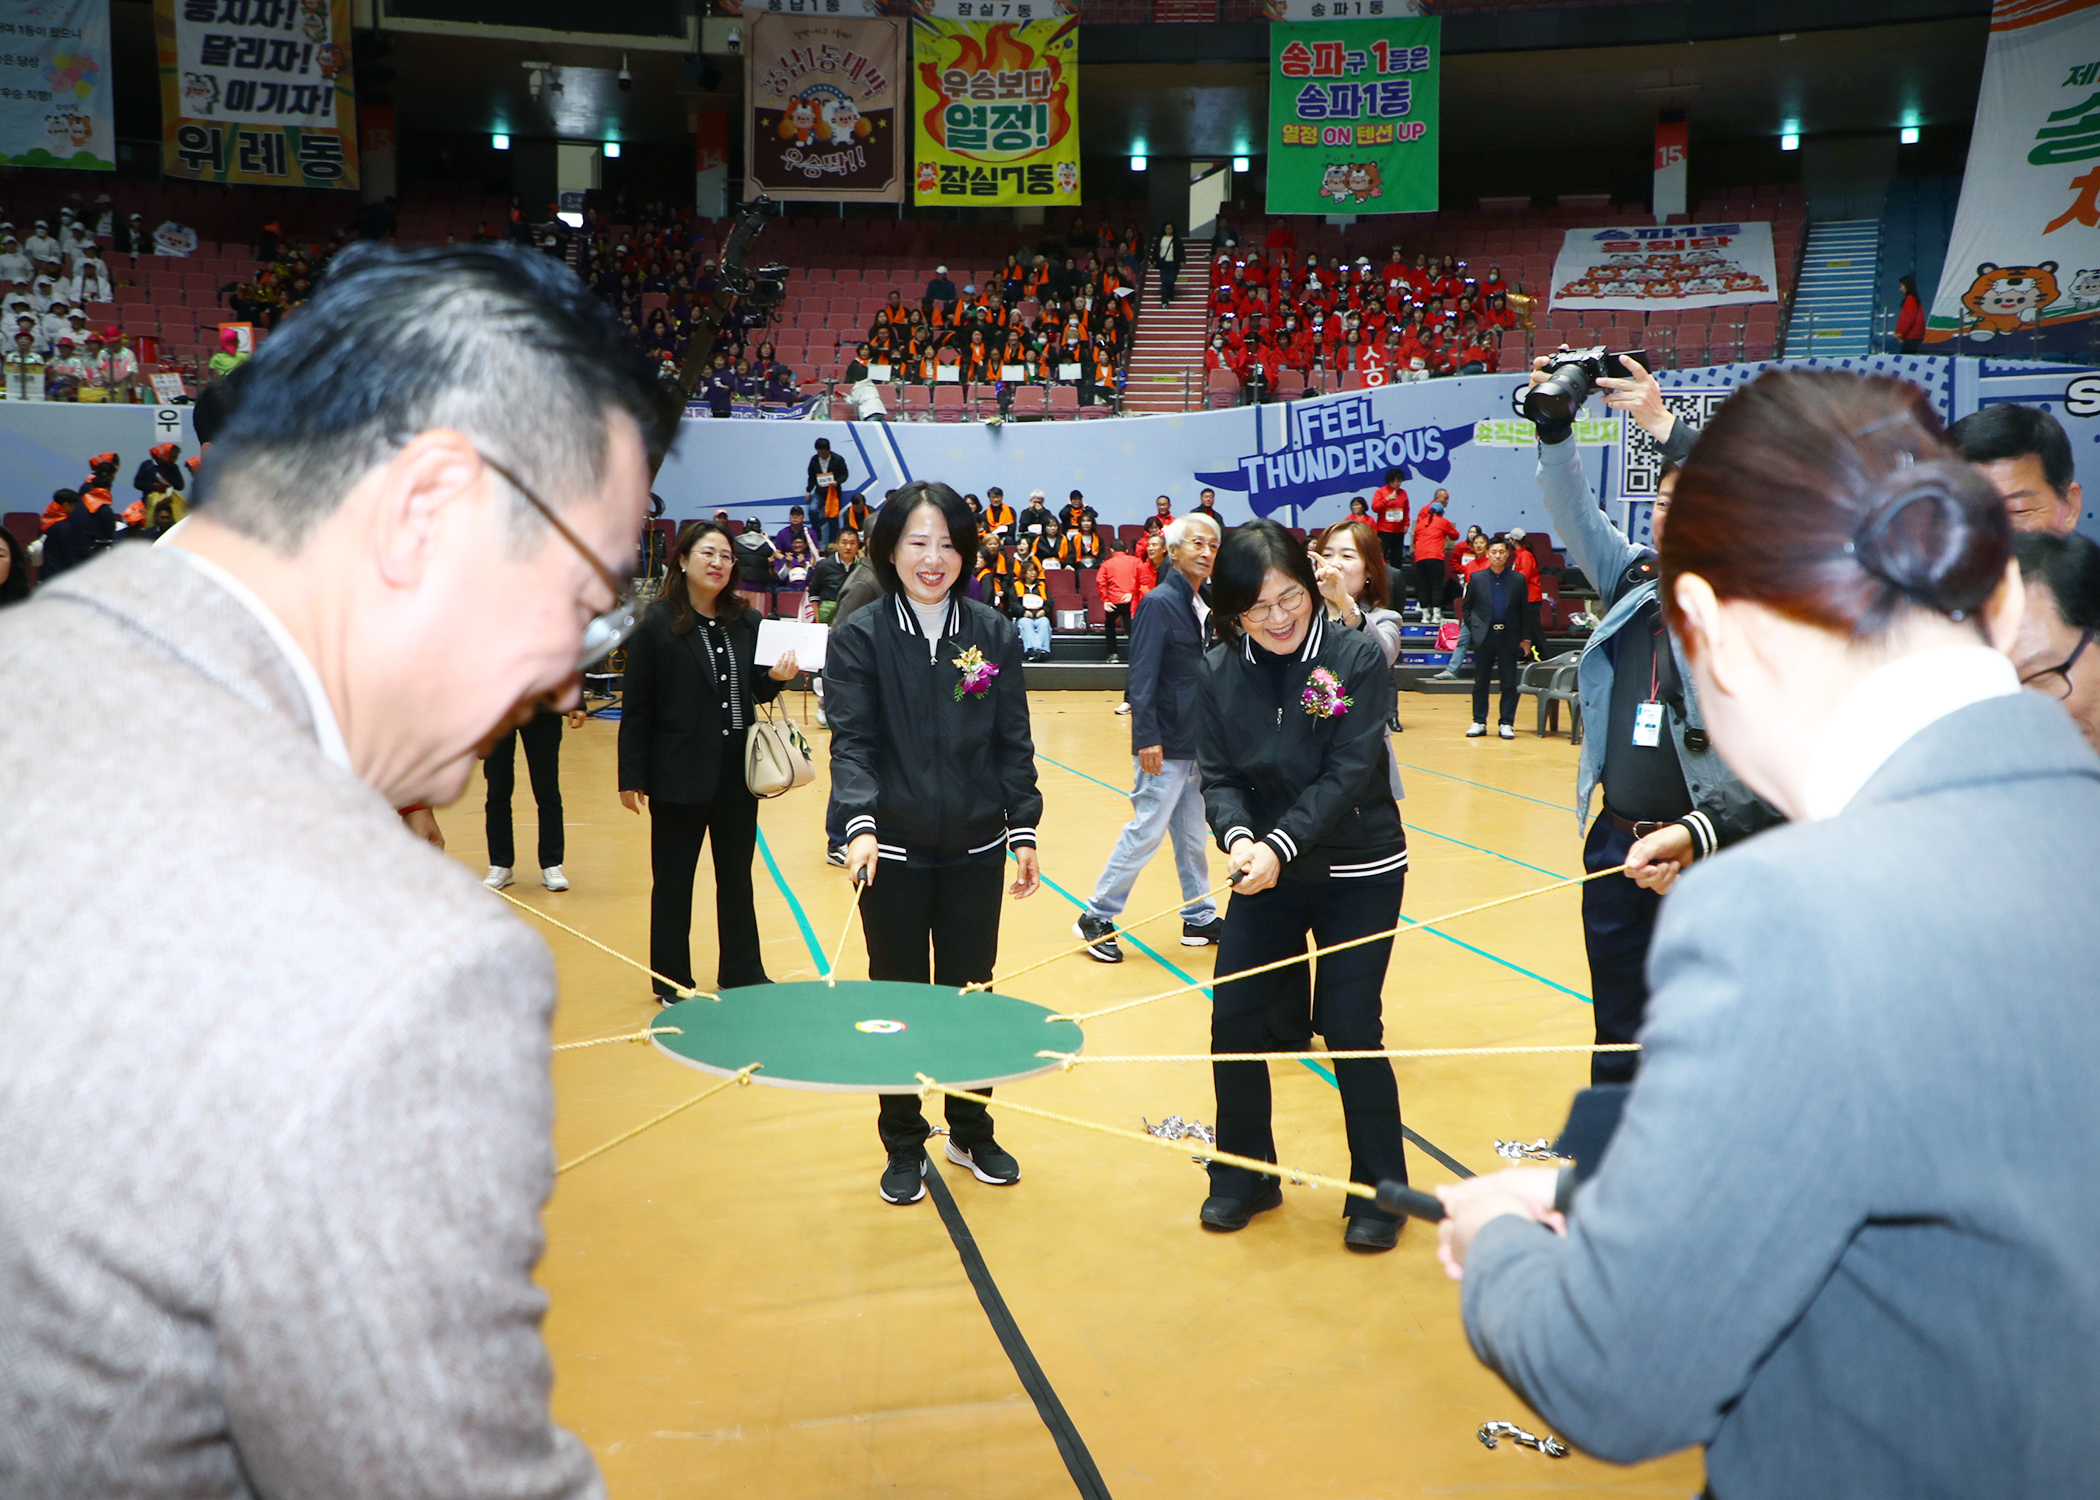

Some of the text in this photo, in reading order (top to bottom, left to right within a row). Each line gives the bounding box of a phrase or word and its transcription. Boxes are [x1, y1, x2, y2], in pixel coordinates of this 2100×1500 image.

[958, 3, 1032, 18] 잠실7동
[1311, 1, 1385, 17] 송파1동
[201, 34, 312, 75] 달리자!
[1280, 39, 1431, 78] 송파구 1등은
[1, 87, 23, 100] 우승
[225, 79, 334, 117] 이기자!
[943, 69, 1051, 101] 우승보다
[1297, 80, 1412, 118] 송파1동
[366, 128, 391, 149] 13
[945, 103, 1049, 151] 열정!
[1282, 122, 1426, 146] 열정 ON 텐션 UP
[177, 125, 346, 181] 위례동
[700, 148, 723, 168] 14
[1658, 145, 1684, 167] 15
[939, 163, 1054, 196] 잠실7동
[1362, 345, 1385, 387] 송
[1299, 398, 1381, 447] FEEL
[1240, 426, 1447, 495] THUNDEROUS
